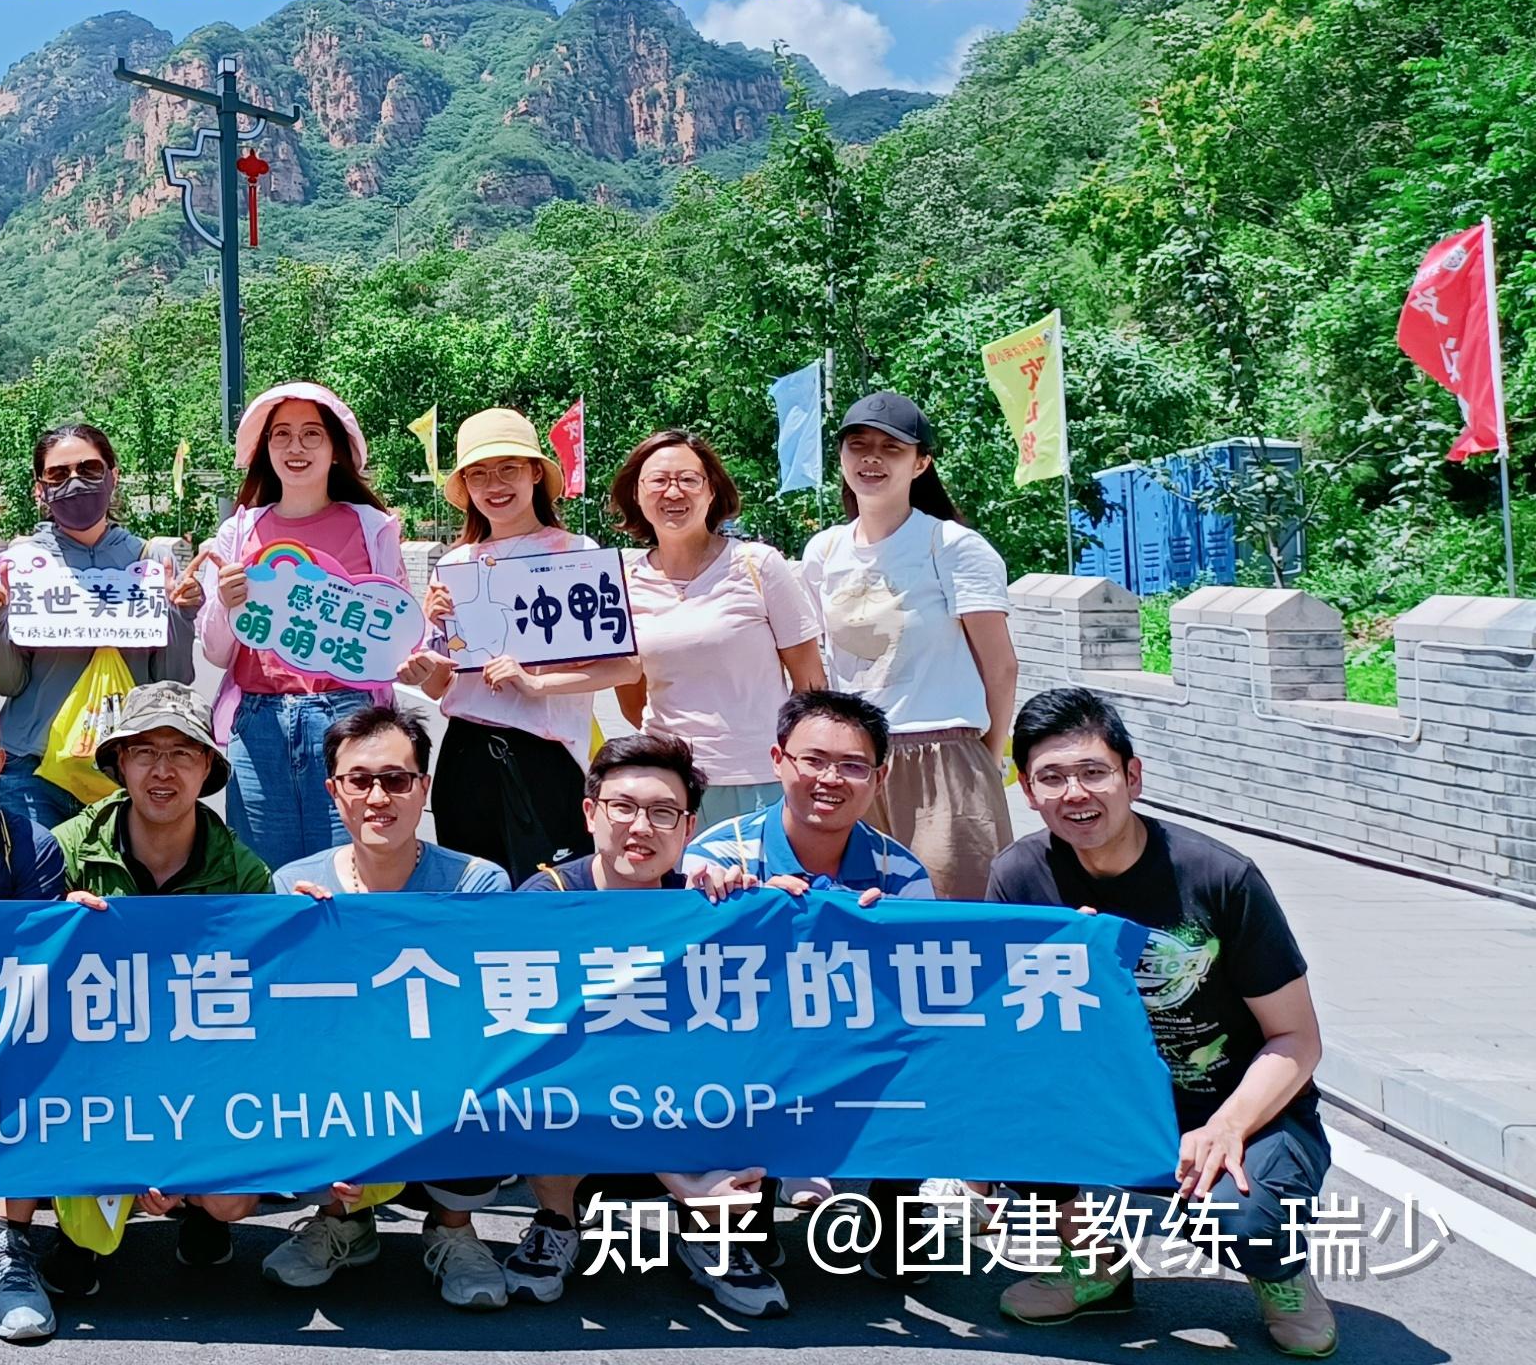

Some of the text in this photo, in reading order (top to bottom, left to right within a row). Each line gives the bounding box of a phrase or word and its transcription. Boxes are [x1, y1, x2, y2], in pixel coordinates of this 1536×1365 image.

[9, 582, 168, 618] 盛世美颜
[285, 580, 395, 644] 感觉自己
[514, 571, 628, 646] 冲鸭
[234, 600, 368, 673] 萌萌哒
[225, 1088, 424, 1141] CHAIN
[454, 1085, 581, 1133] AND
[609, 1080, 815, 1133] S&OP+
